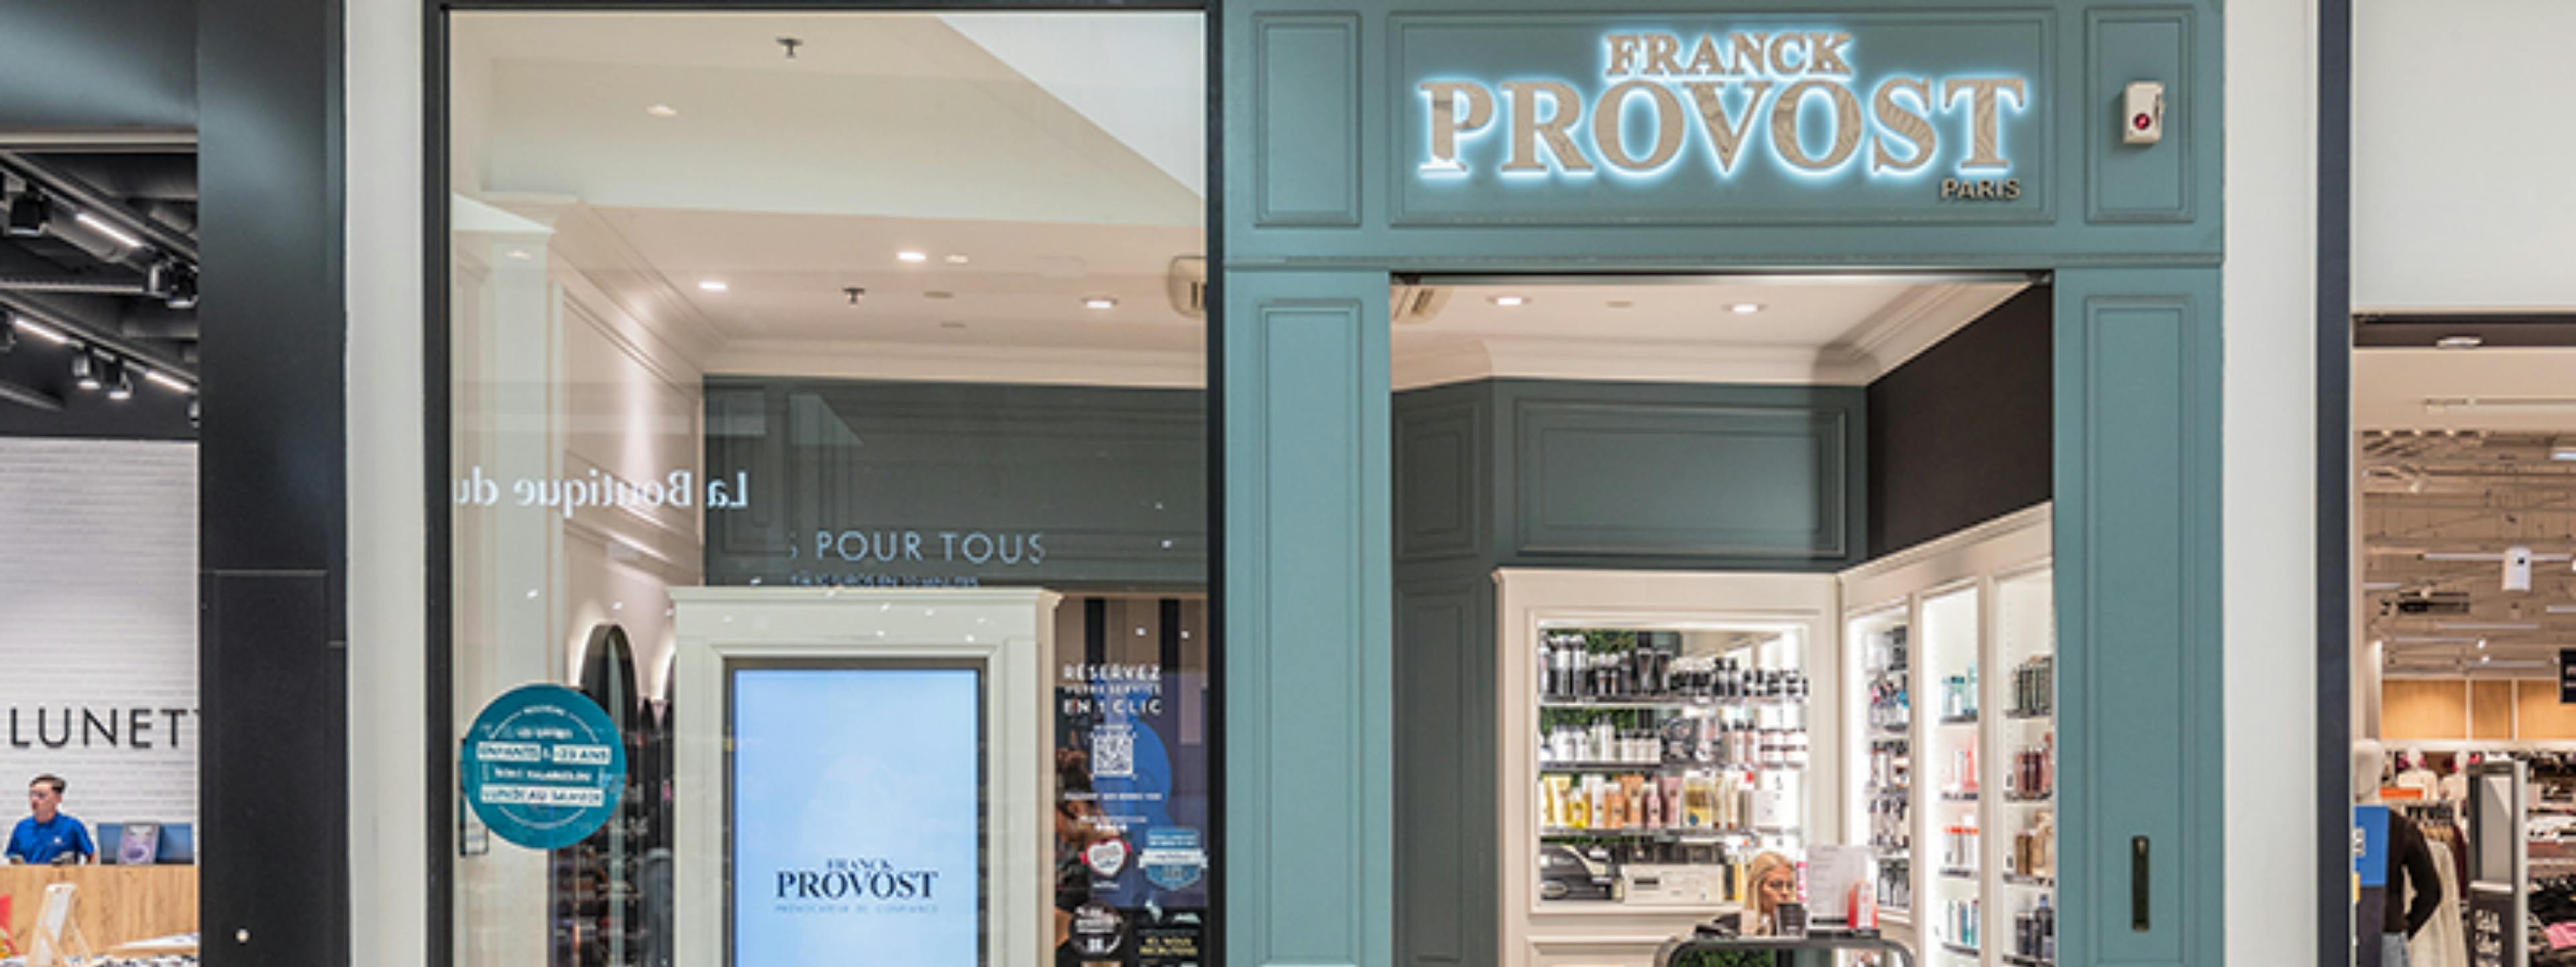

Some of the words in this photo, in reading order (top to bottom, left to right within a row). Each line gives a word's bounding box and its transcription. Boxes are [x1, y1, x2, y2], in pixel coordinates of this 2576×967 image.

[1604, 32, 1854, 77] FRANCK
[1417, 77, 2026, 174] PROVOST
[1940, 179, 2021, 201] PARIS
[815, 529, 924, 562] POUR
[938, 531, 1046, 564] TOUS
[1112, 699, 1163, 715] CLIC
[9, 708, 200, 748] LUNET
[827, 858, 894, 871] FRANCK
[775, 870, 939, 899] PROVOST
